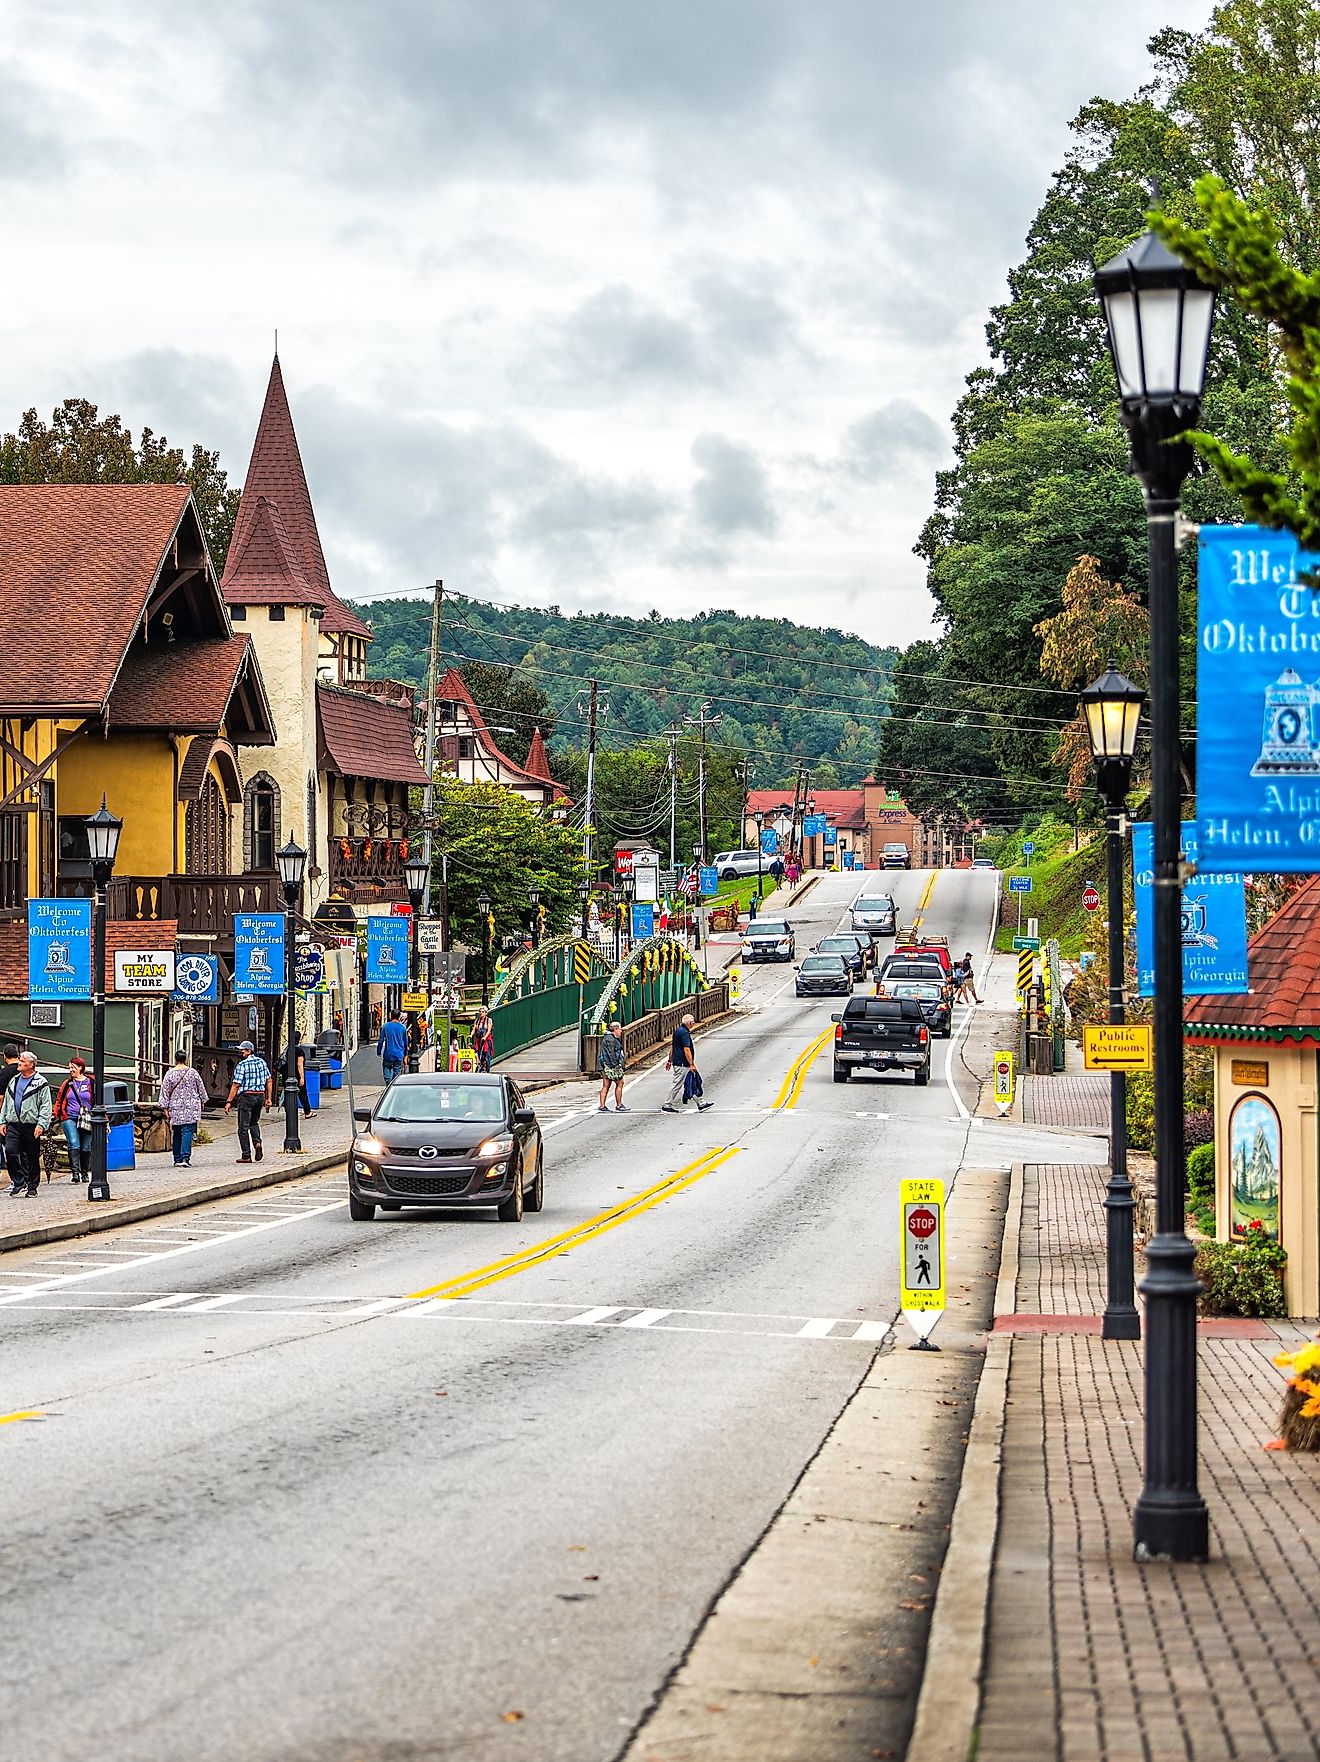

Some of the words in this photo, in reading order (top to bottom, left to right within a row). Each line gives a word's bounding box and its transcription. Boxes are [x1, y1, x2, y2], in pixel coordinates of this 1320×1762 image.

[1262, 784, 1320, 818] Alpi
[878, 810, 907, 818] Express
[1204, 818, 1290, 846] Helen,
[1084, 895, 1098, 904] STOP
[37, 905, 82, 919] Welcome
[52, 916, 67, 926] To
[241, 919, 277, 929] Welcome
[373, 920, 403, 929] Welcome
[29, 925, 89, 937] Oktoberfest
[253, 927, 266, 936] To
[235, 934, 283, 944] Oktoberfest
[367, 933, 408, 942] Oktoberfest
[420, 935, 439, 943] Castle
[423, 942, 437, 950] Inn
[136, 955, 153, 963] MY
[1184, 953, 1217, 968] lpine
[122, 964, 167, 977] TEAM
[195, 960, 211, 978] RIVER
[379, 966, 396, 974] Alpine
[47, 974, 74, 985] Alpine
[249, 973, 271, 982] Alpine
[295, 972, 315, 983] Shop
[1190, 967, 1246, 985] Georgia
[128, 979, 162, 987] STORE
[196, 980, 209, 991] CO.
[236, 980, 257, 989] Helen,
[258, 980, 284, 990] Georgia
[30, 984, 56, 993] Helen,
[57, 984, 90, 995] Georgia
[1099, 1030, 1135, 1041] Public
[1090, 1043, 1146, 1052] Restrooms
[908, 1183, 935, 1191] STATE
[909, 1218, 935, 1229] STOP
